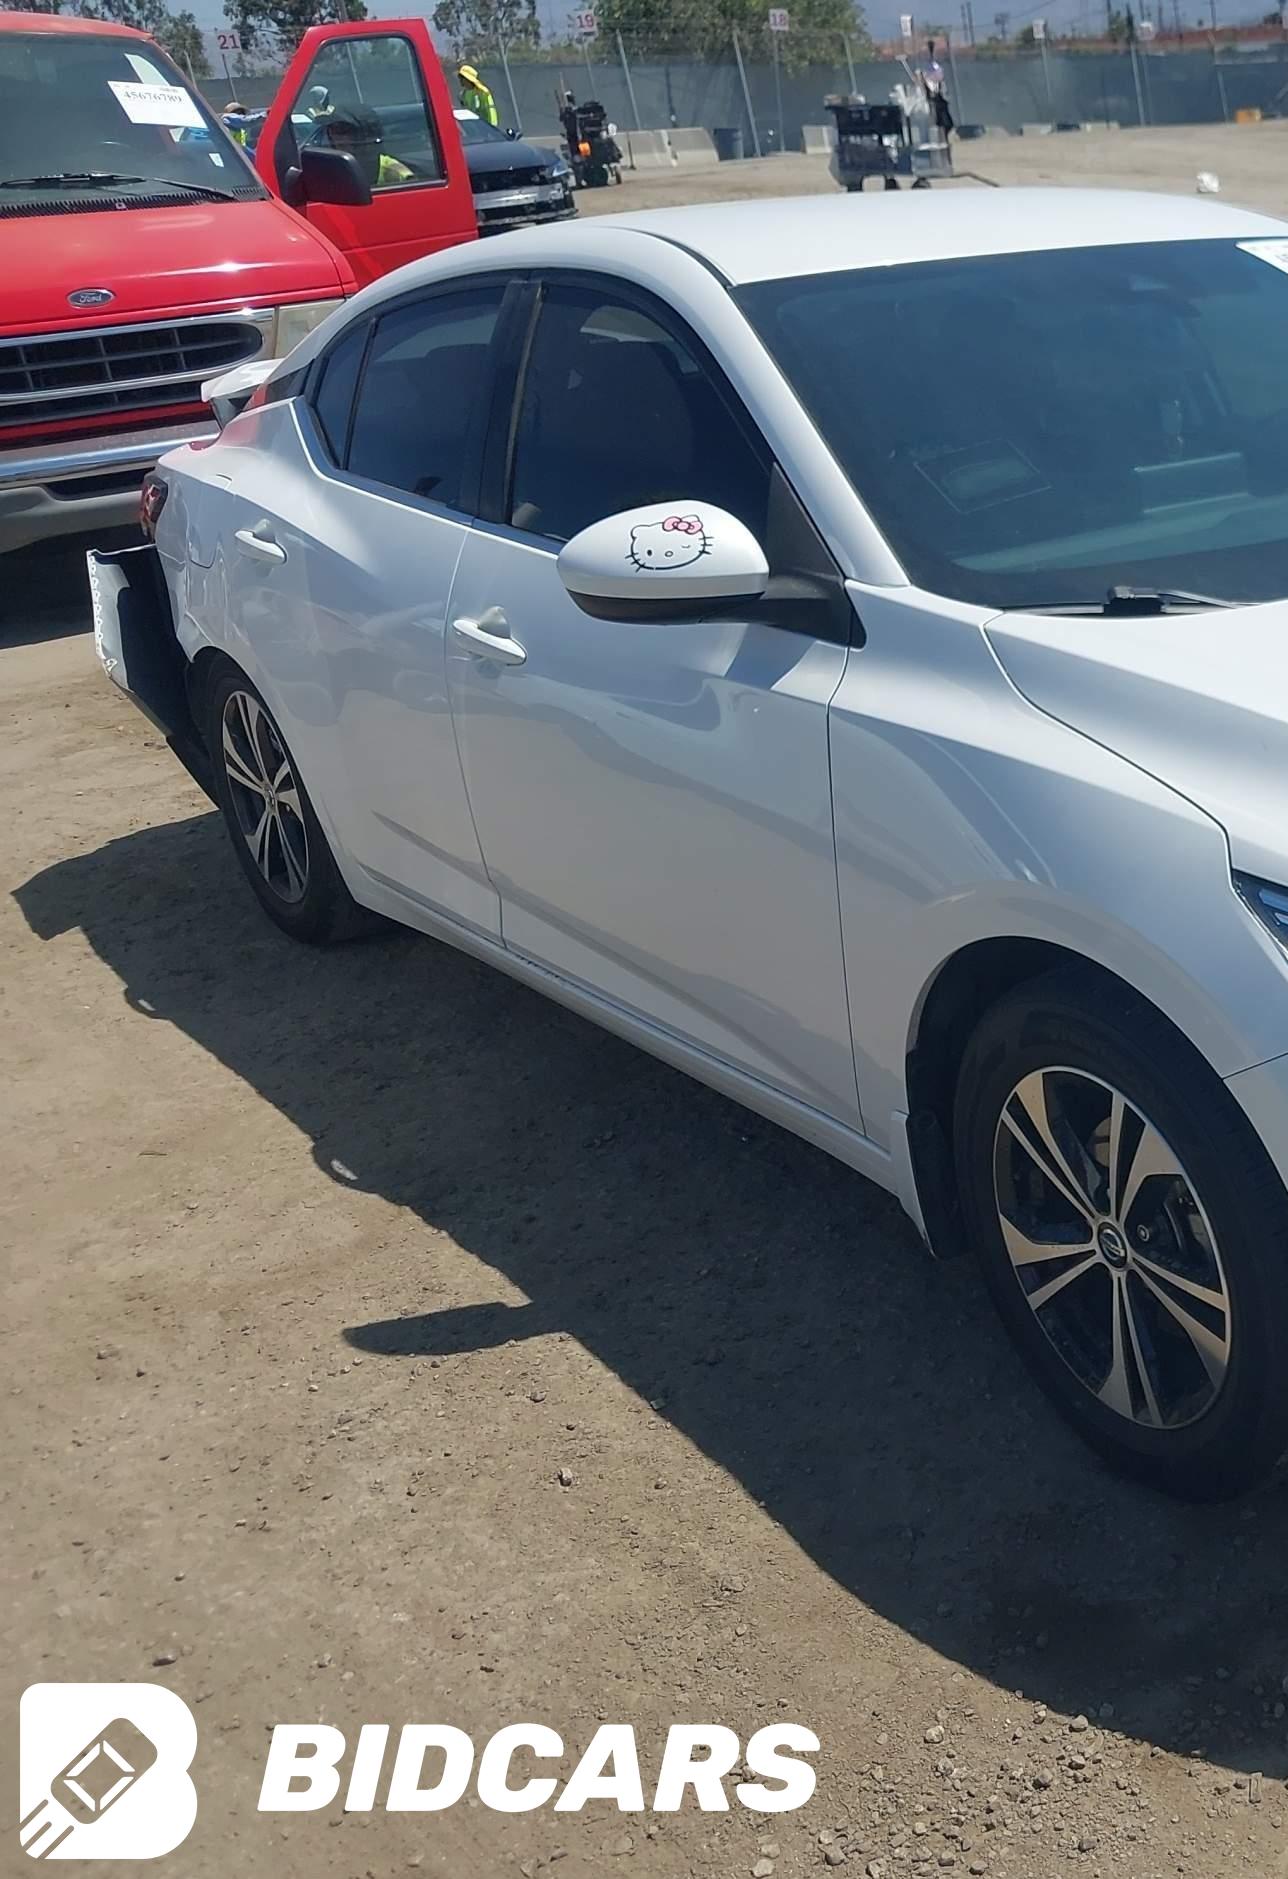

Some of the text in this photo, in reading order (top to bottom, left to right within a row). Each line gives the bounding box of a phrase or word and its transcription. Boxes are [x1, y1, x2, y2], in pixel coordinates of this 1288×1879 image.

[576, 14, 594, 28] 19
[217, 34, 240, 49] 21
[79, 293, 102, 303] Ford
